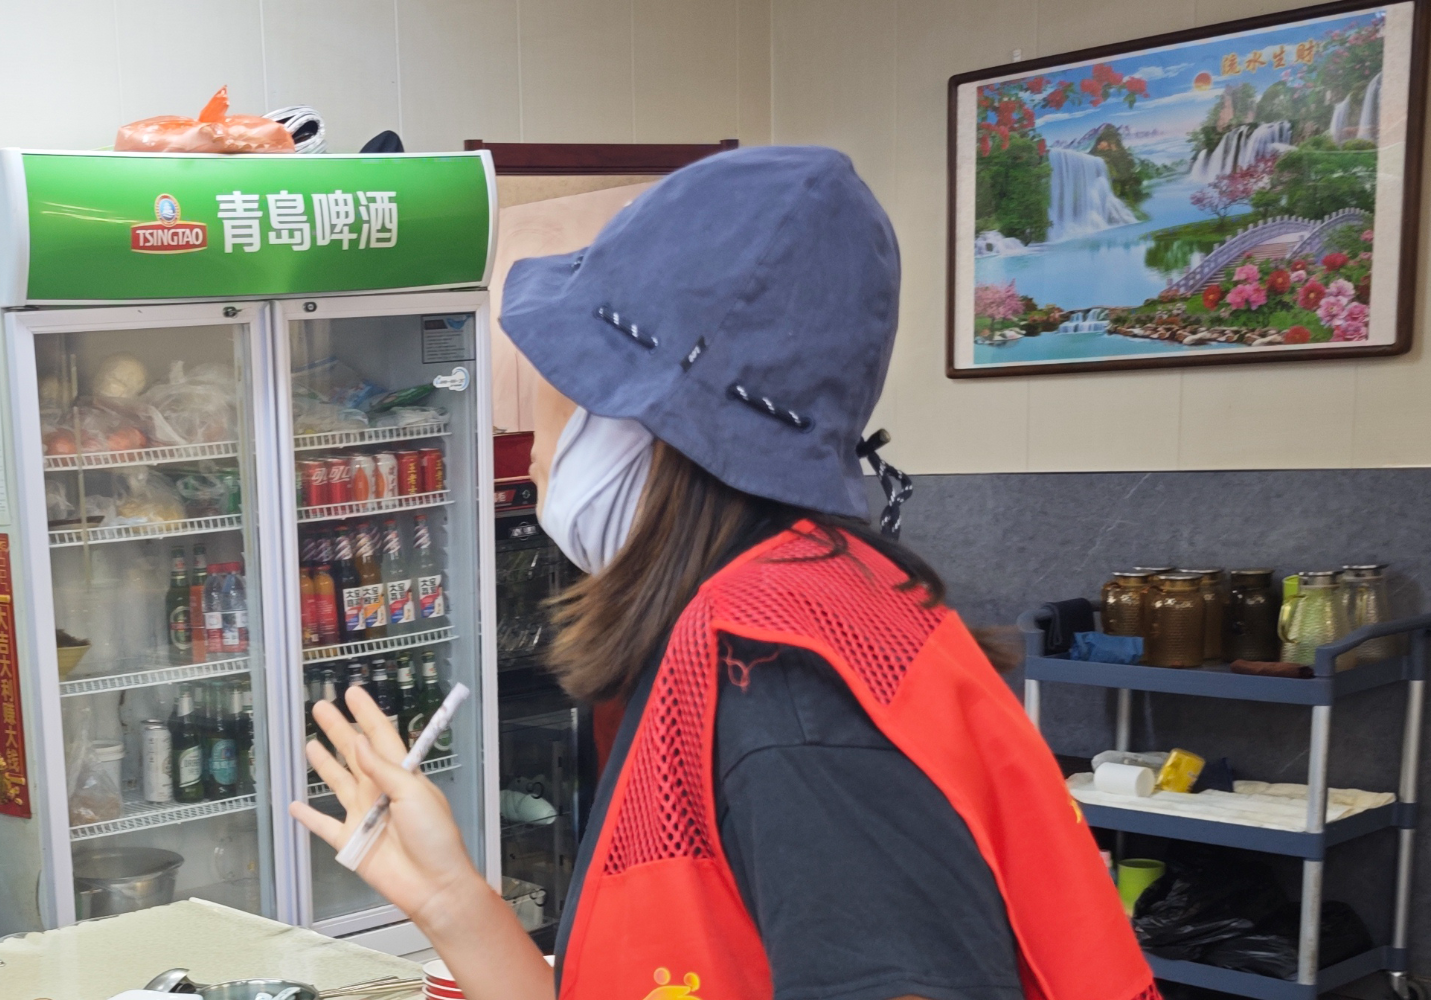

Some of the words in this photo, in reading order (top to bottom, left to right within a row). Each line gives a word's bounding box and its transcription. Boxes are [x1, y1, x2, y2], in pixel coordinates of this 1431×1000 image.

[1221, 38, 1315, 76] 流水生财
[135, 228, 203, 247] TSINGTAO
[216, 189, 399, 254] 青岛啤酒
